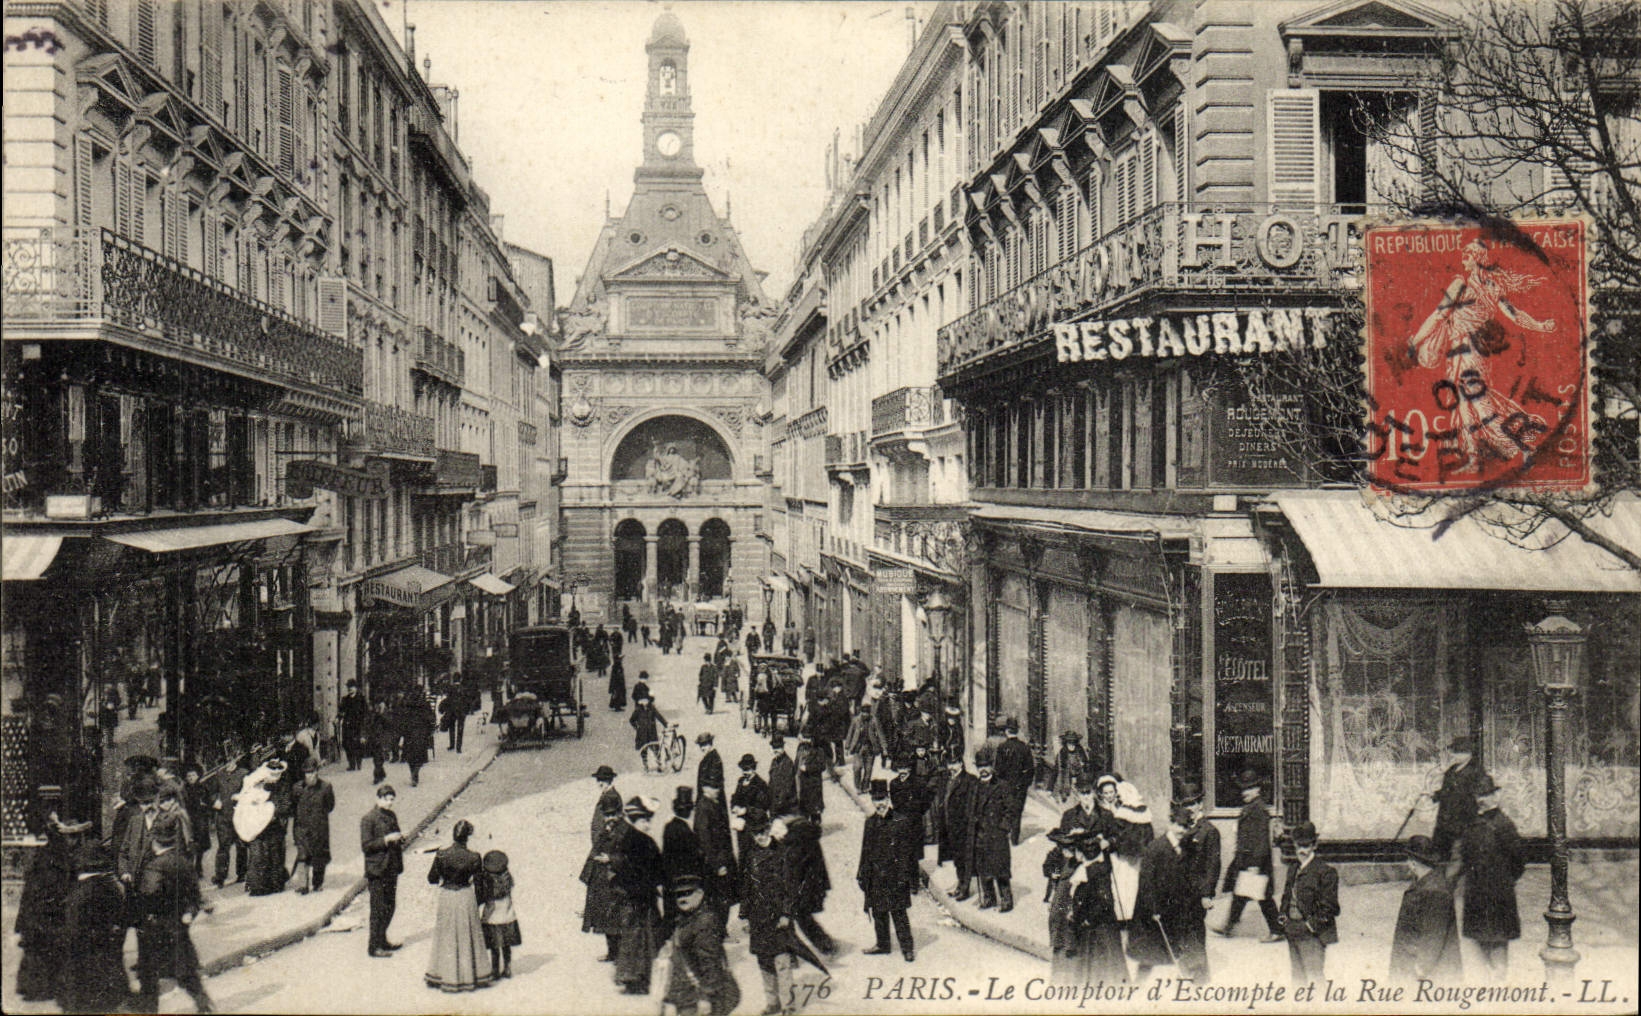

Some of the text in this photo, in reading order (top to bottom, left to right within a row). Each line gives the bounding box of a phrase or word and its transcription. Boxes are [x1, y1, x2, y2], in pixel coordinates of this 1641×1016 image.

[1046, 307, 1332, 363] RESTAURANT
[362, 580, 419, 603] RESTAURANT
[1216, 732, 1274, 754] RESTAURANT
